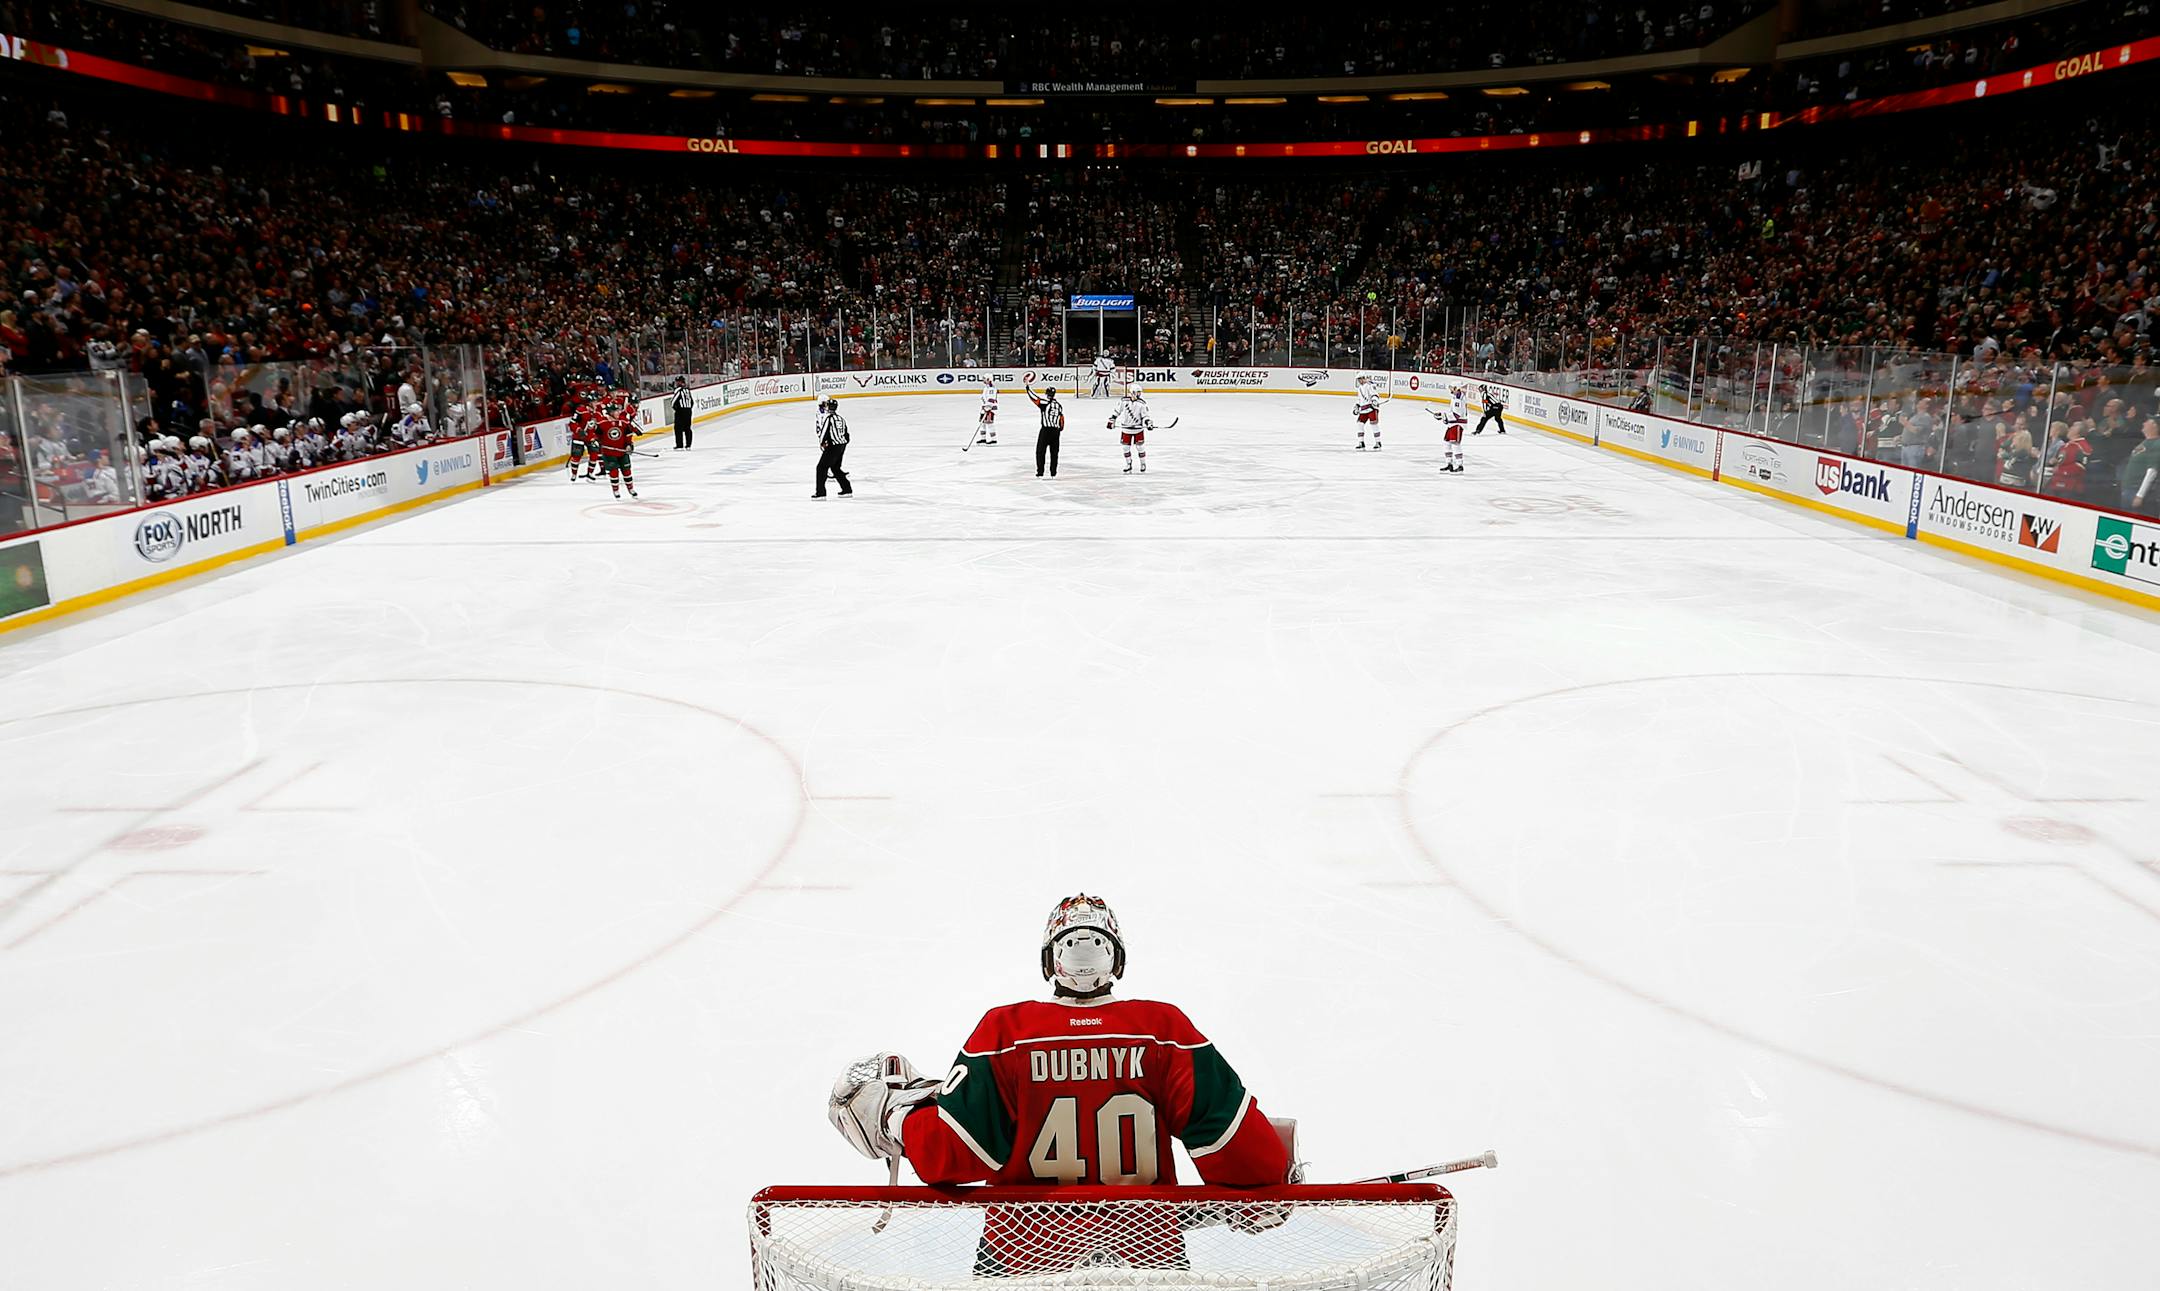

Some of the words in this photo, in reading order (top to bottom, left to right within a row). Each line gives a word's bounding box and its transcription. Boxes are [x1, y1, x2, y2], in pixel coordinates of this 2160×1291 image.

[2055, 51, 2104, 80] GOAL
[1032, 83, 1050, 91] RBC
[1052, 82, 1084, 91] Wealth
[1086, 82, 1144, 93] Management
[687, 138, 739, 153] GOAL
[1366, 140, 1417, 154] GOAL
[873, 374, 898, 385] JACK
[957, 374, 1014, 382] POLRIS
[1041, 373, 1063, 382] Xcel
[779, 383, 800, 394] zero
[433, 454, 472, 476] @MNWILD
[277, 481, 293, 531] Reebok
[1909, 472, 1923, 525] Reebok
[1930, 485, 2015, 530] Andersen
[144, 520, 174, 546] FOX
[186, 504, 242, 543] NORTH
[146, 539, 176, 556] SPORTS
[2096, 533, 2160, 567] ent
[1069, 1017, 1103, 1026] Reebok
[1030, 1046, 1146, 1082] DUBNYK
[1028, 1093, 1158, 1186] 40
